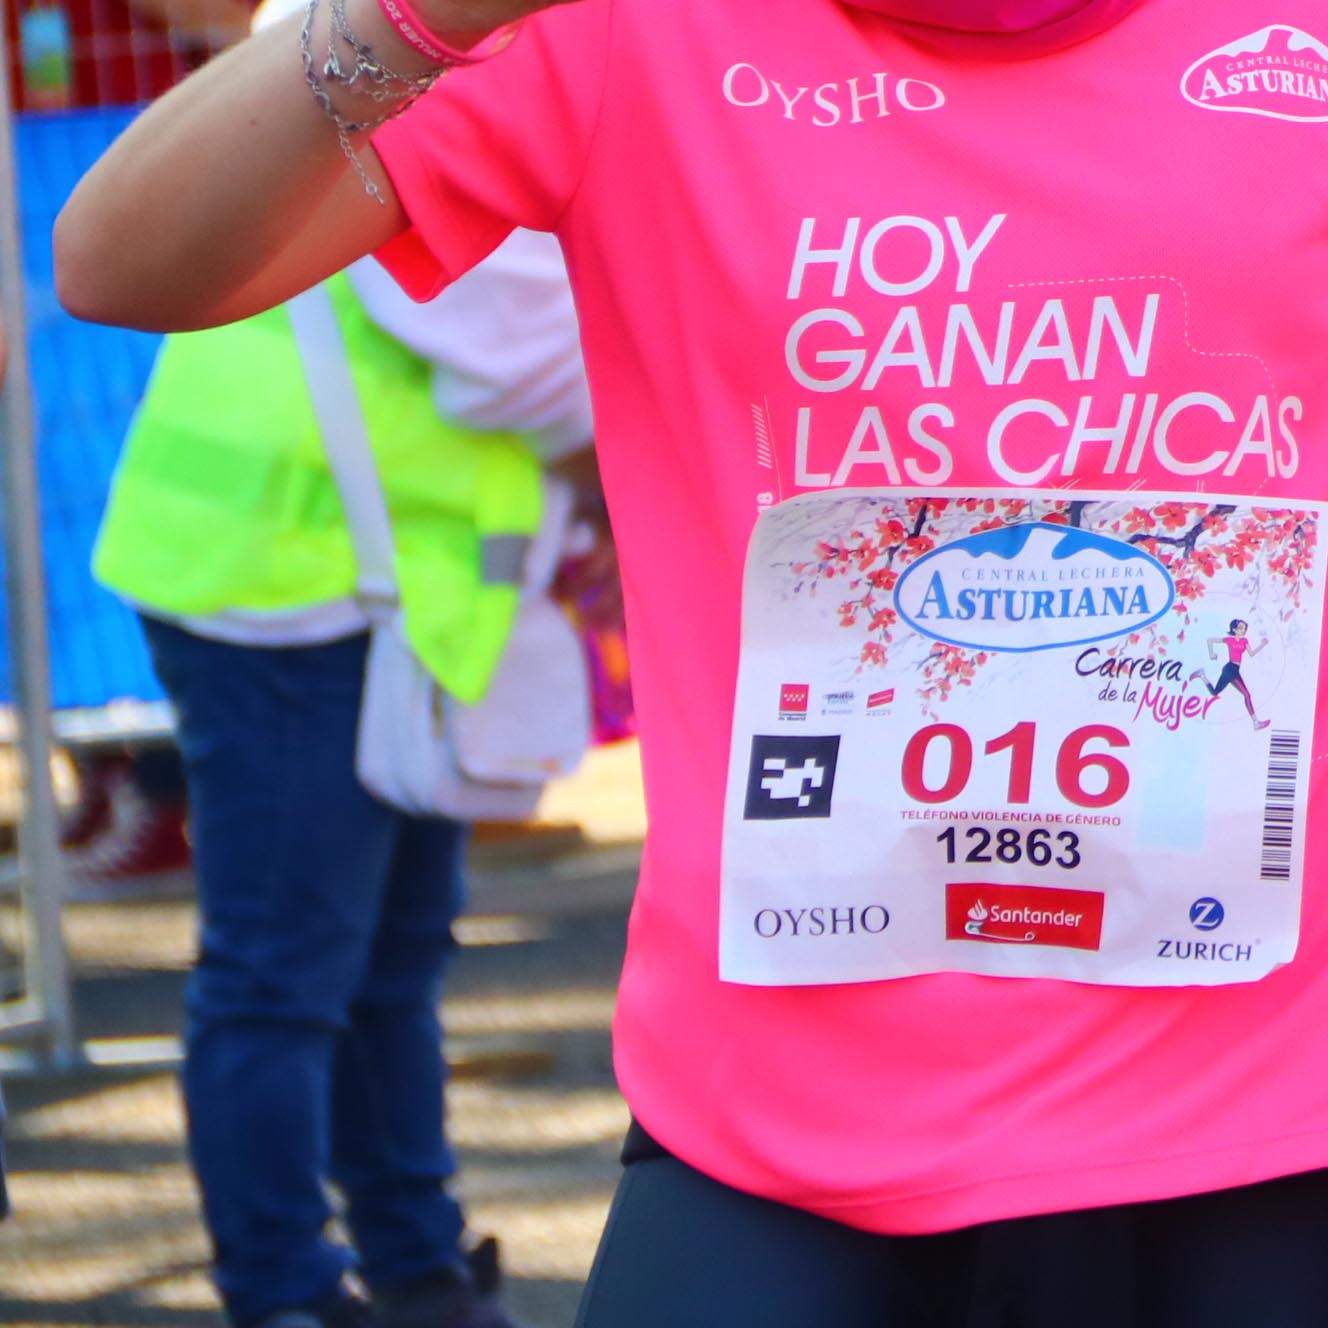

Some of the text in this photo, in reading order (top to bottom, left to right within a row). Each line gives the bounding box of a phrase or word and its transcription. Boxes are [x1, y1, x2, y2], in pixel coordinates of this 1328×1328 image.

[1225, 55, 1289, 72] CENTRAL
[722, 62, 946, 127] OYSHO
[785, 213, 1007, 300] HOY
[784, 293, 1160, 393] GANAN
[794, 392, 1303, 487] LAS CHICAS
[915, 570, 1151, 622] ASTURIANA
[961, 566, 1145, 582] CENTRAL LECHERA
[1075, 647, 1184, 681] Carrera
[1097, 680, 1221, 731] de la Mujer
[901, 721, 1131, 809] 016
[900, 808, 1122, 827] TELÉFONO VIOLENCIA DE GÉNERO
[936, 826, 1081, 870] 12863
[753, 904, 891, 939] OYSHO
[989, 905, 1083, 929] Santander
[1156, 939, 1252, 962] ZURICH
